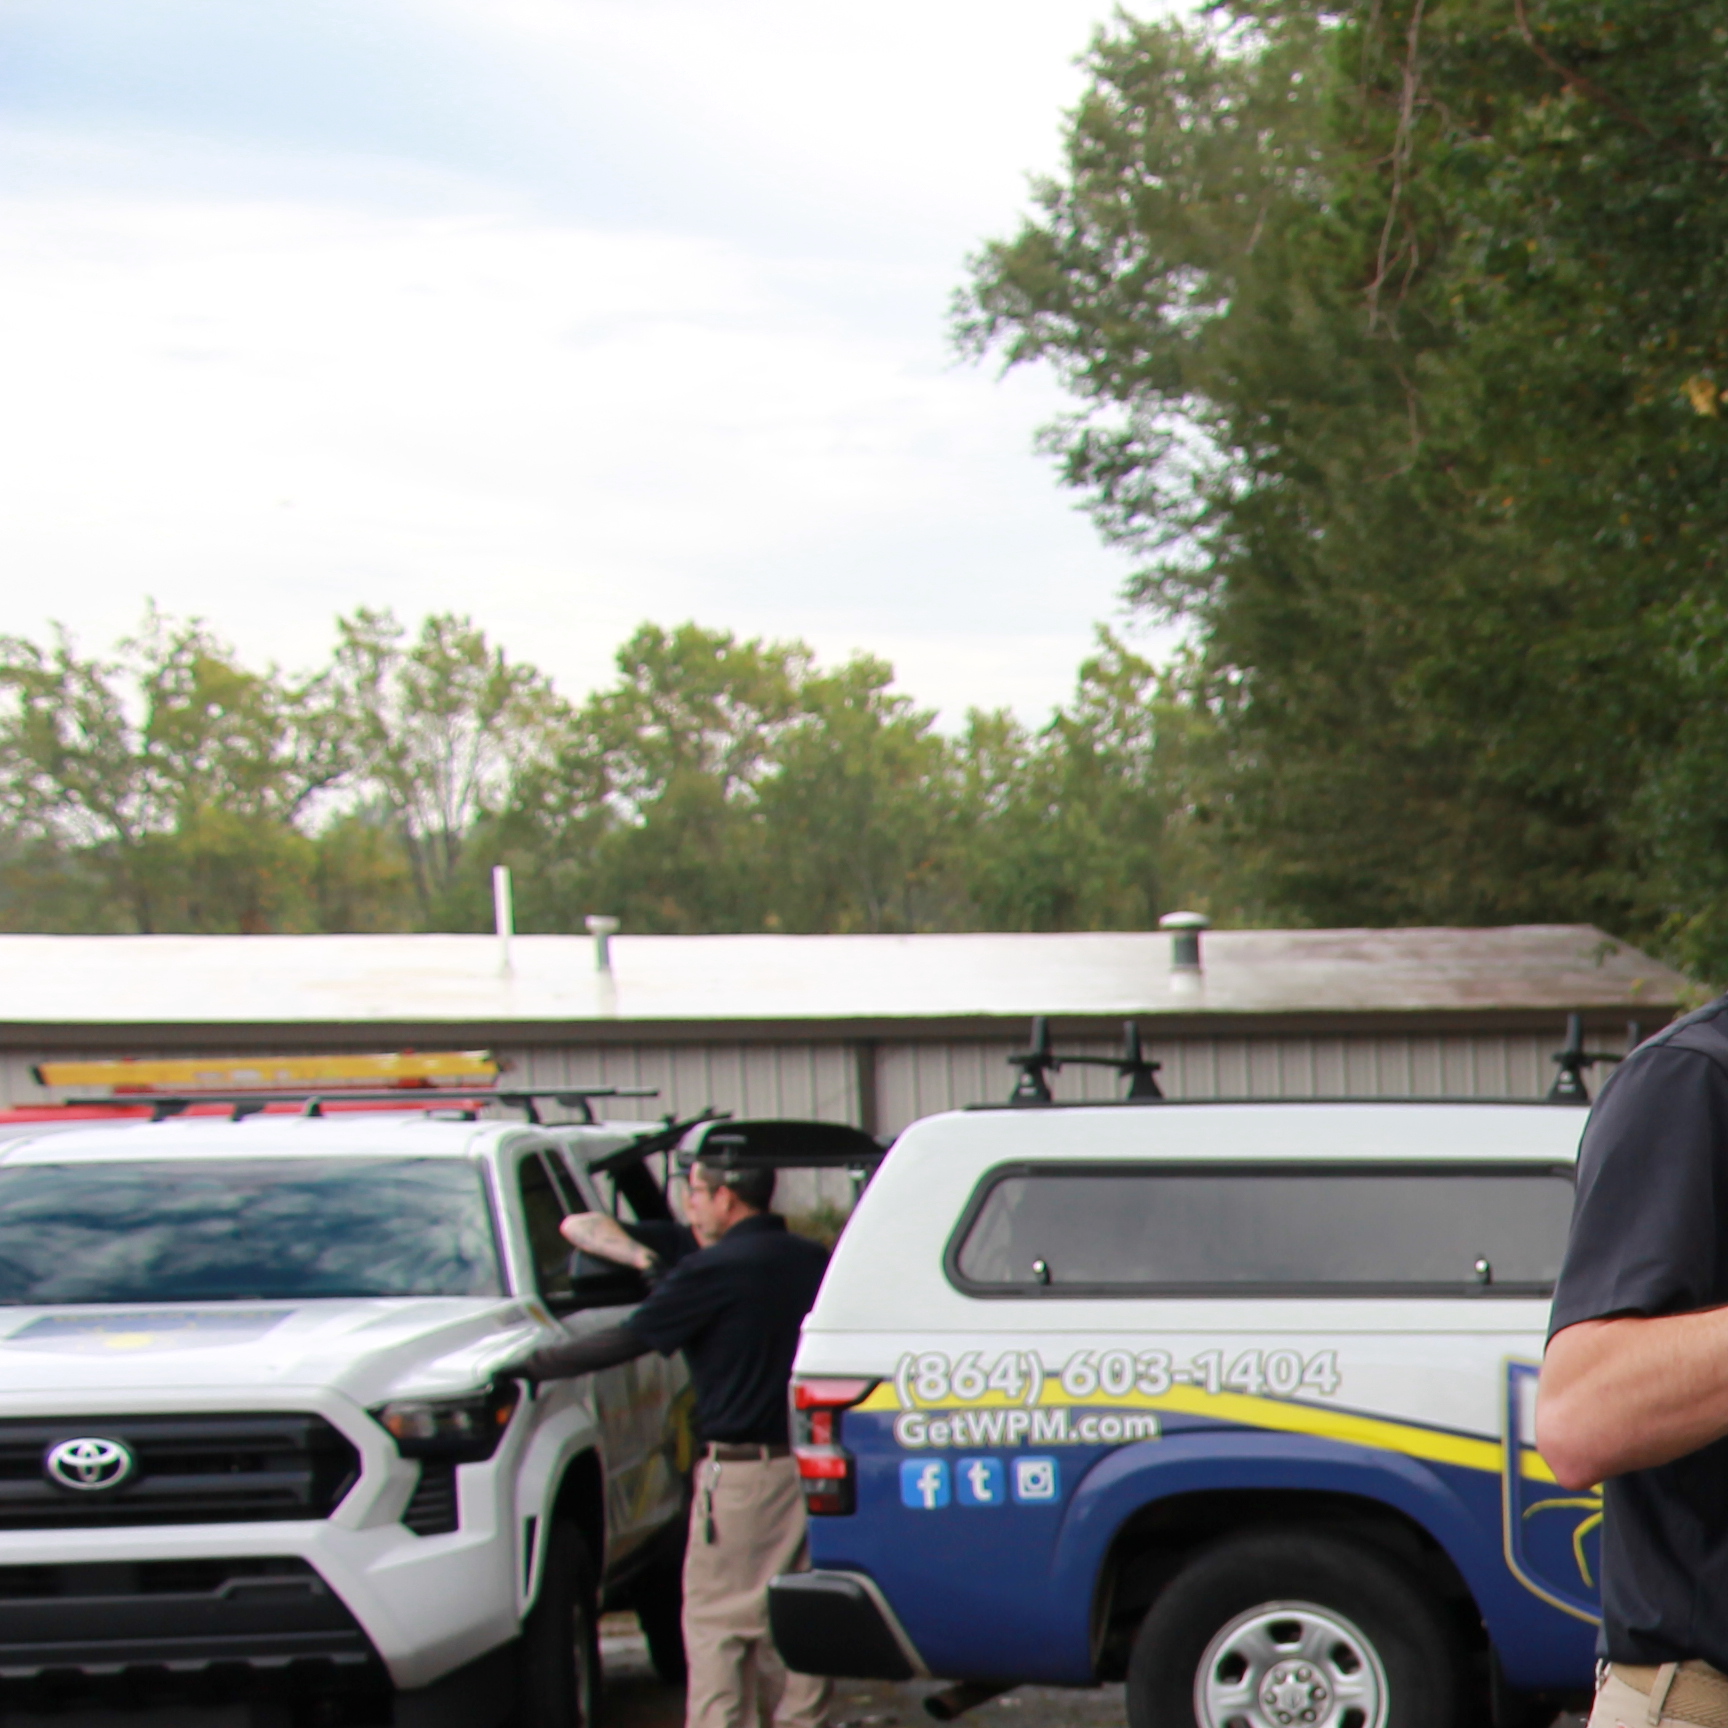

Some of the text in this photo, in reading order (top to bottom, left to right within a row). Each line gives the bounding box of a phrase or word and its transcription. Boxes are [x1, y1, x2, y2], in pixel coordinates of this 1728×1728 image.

[895, 1349, 1340, 1408] (864) 603-1404
[896, 1411, 1162, 1446] GetWPM.com
